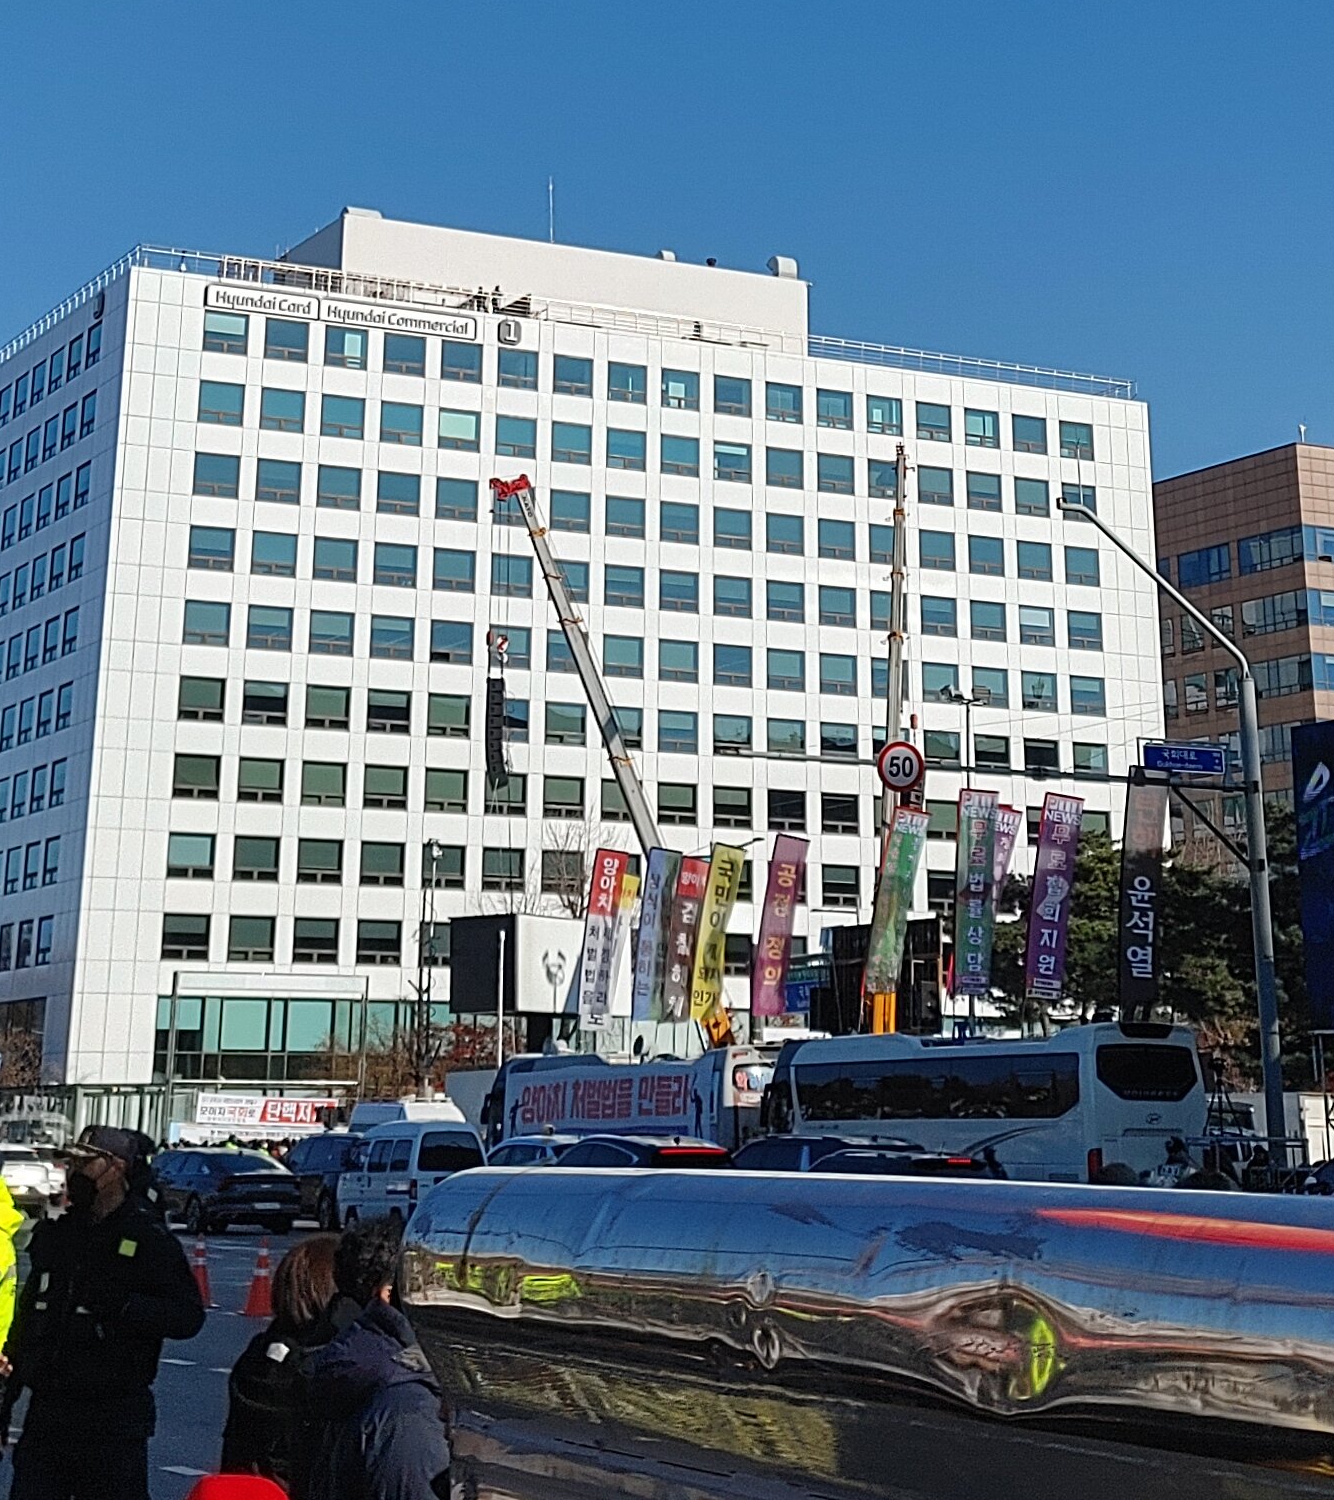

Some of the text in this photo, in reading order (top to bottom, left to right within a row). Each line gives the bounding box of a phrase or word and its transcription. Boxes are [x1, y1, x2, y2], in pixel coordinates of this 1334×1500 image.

[216, 290, 312, 315] Hyundai Card
[327, 304, 468, 335] Hyundai Commercial
[888, 755, 914, 778] 50
[994, 821, 1018, 836] EWS
[1044, 809, 1082, 826] NEWS
[597, 858, 620, 913] 양아치
[1125, 875, 1157, 978] 윤석열
[521, 1081, 568, 1125] 양아치
[571, 1074, 634, 1120] 처벌법을
[638, 1073, 690, 1117] 만들라
